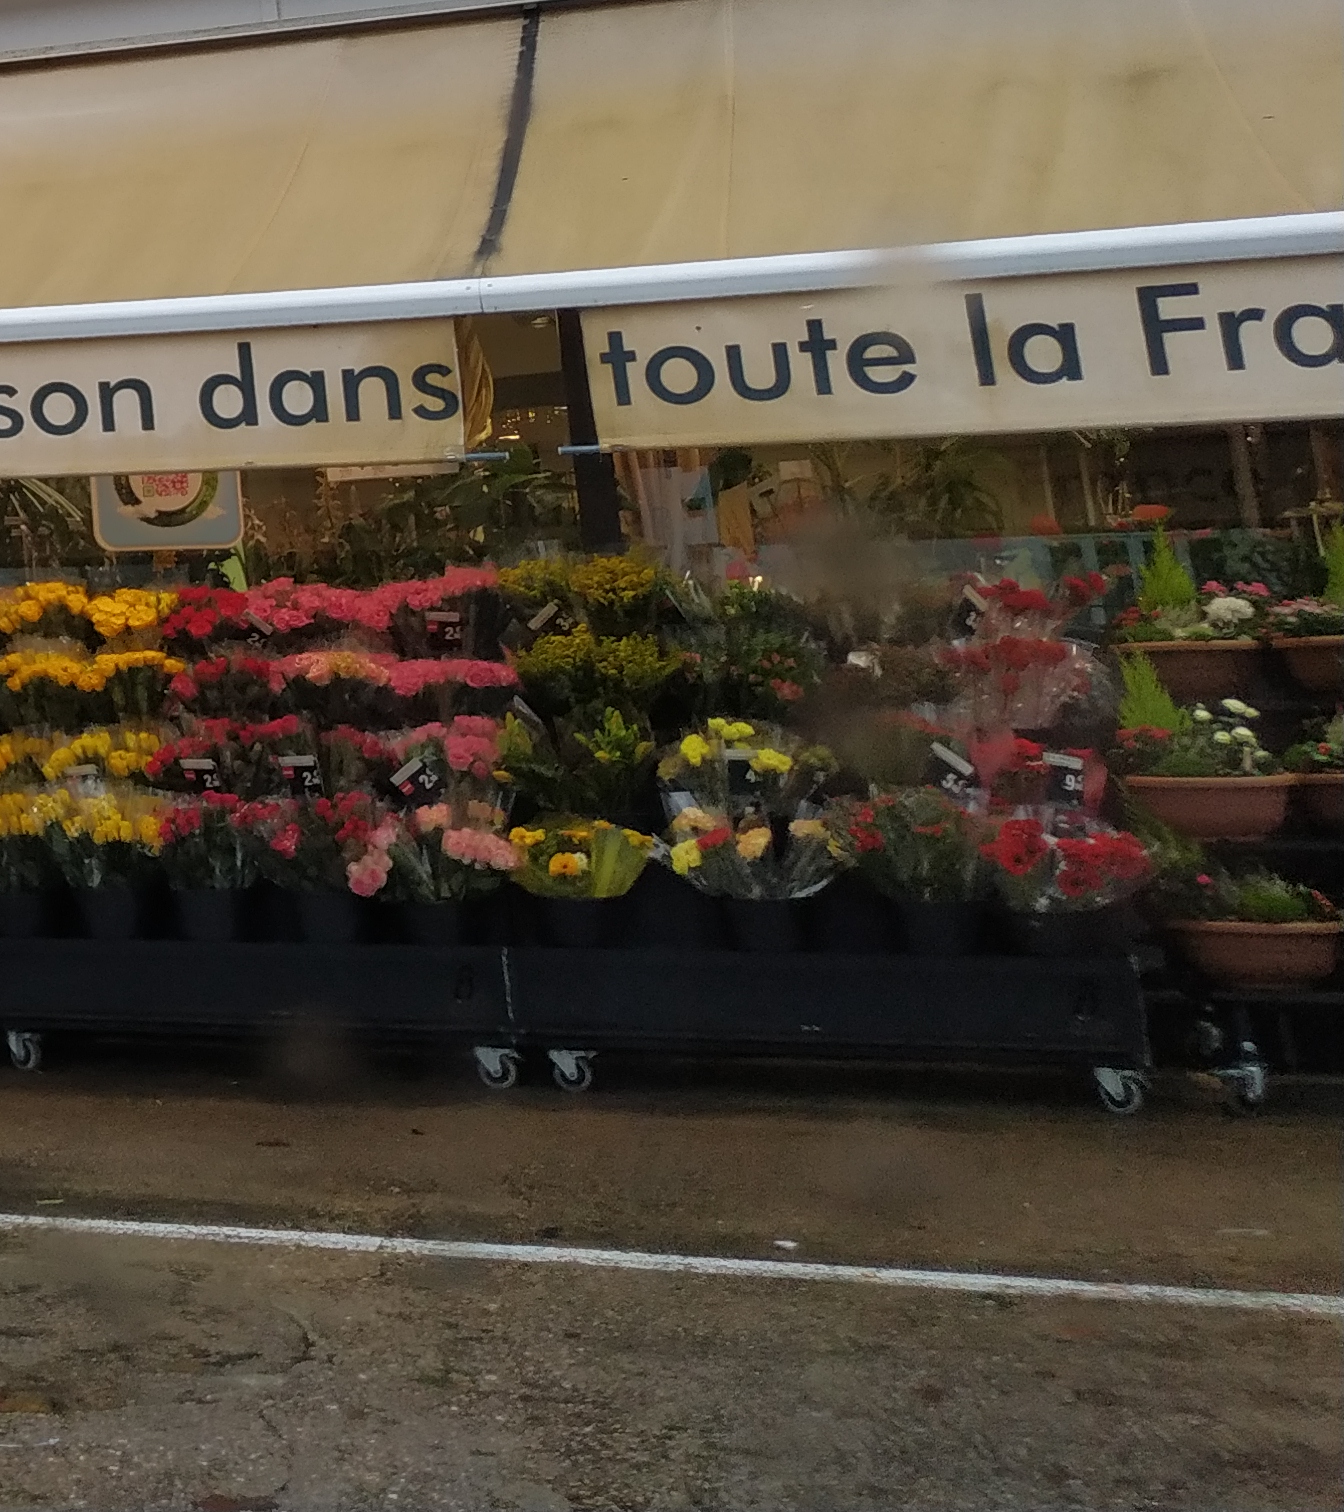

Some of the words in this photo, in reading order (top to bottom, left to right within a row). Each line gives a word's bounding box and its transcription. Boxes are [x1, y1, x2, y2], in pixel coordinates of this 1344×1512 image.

[198, 341, 461, 431] dans
[599, 318, 919, 406] toute
[964, 292, 1083, 387] la
[1134, 281, 1344, 377] Fra
